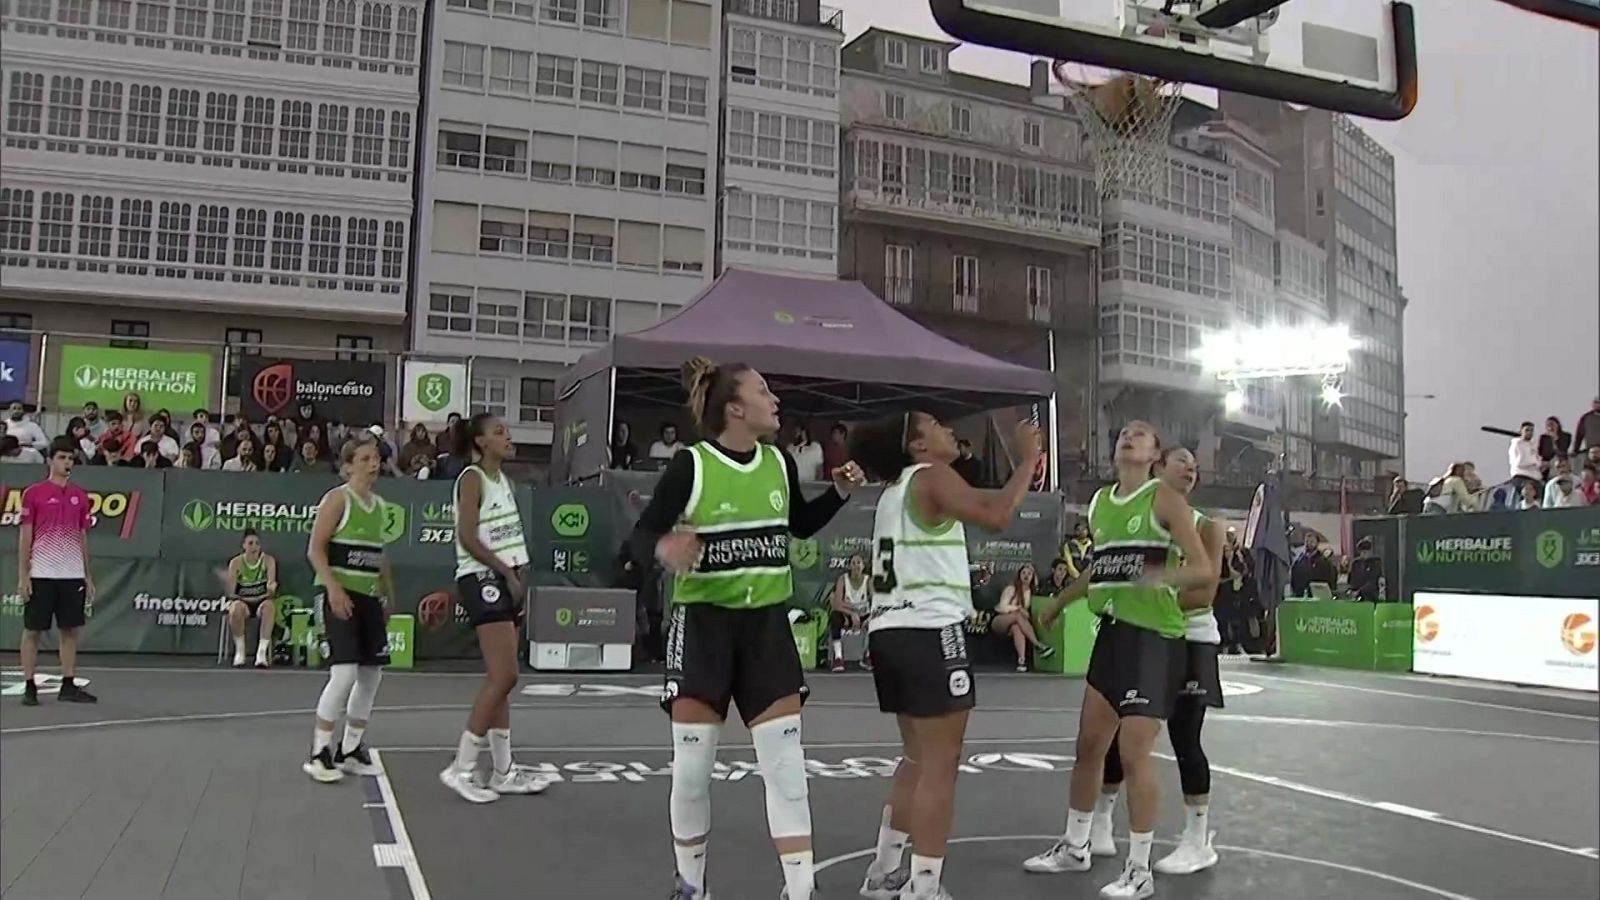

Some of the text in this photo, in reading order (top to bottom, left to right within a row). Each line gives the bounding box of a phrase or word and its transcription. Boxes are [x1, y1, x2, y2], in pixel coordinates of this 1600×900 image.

[101, 367, 197, 383] HERBALIFE
[101, 379, 197, 394] NUTRITION
[296, 379, 373, 397] baloncesto
[216, 502, 321, 519] HERBALIF
[216, 517, 316, 533] NUTRITIO
[1436, 537, 1513, 551] HERBALIFE
[1435, 550, 1512, 563] NUTRITION
[873, 537, 897, 594] 3
[134, 593, 232, 612] finetwork
